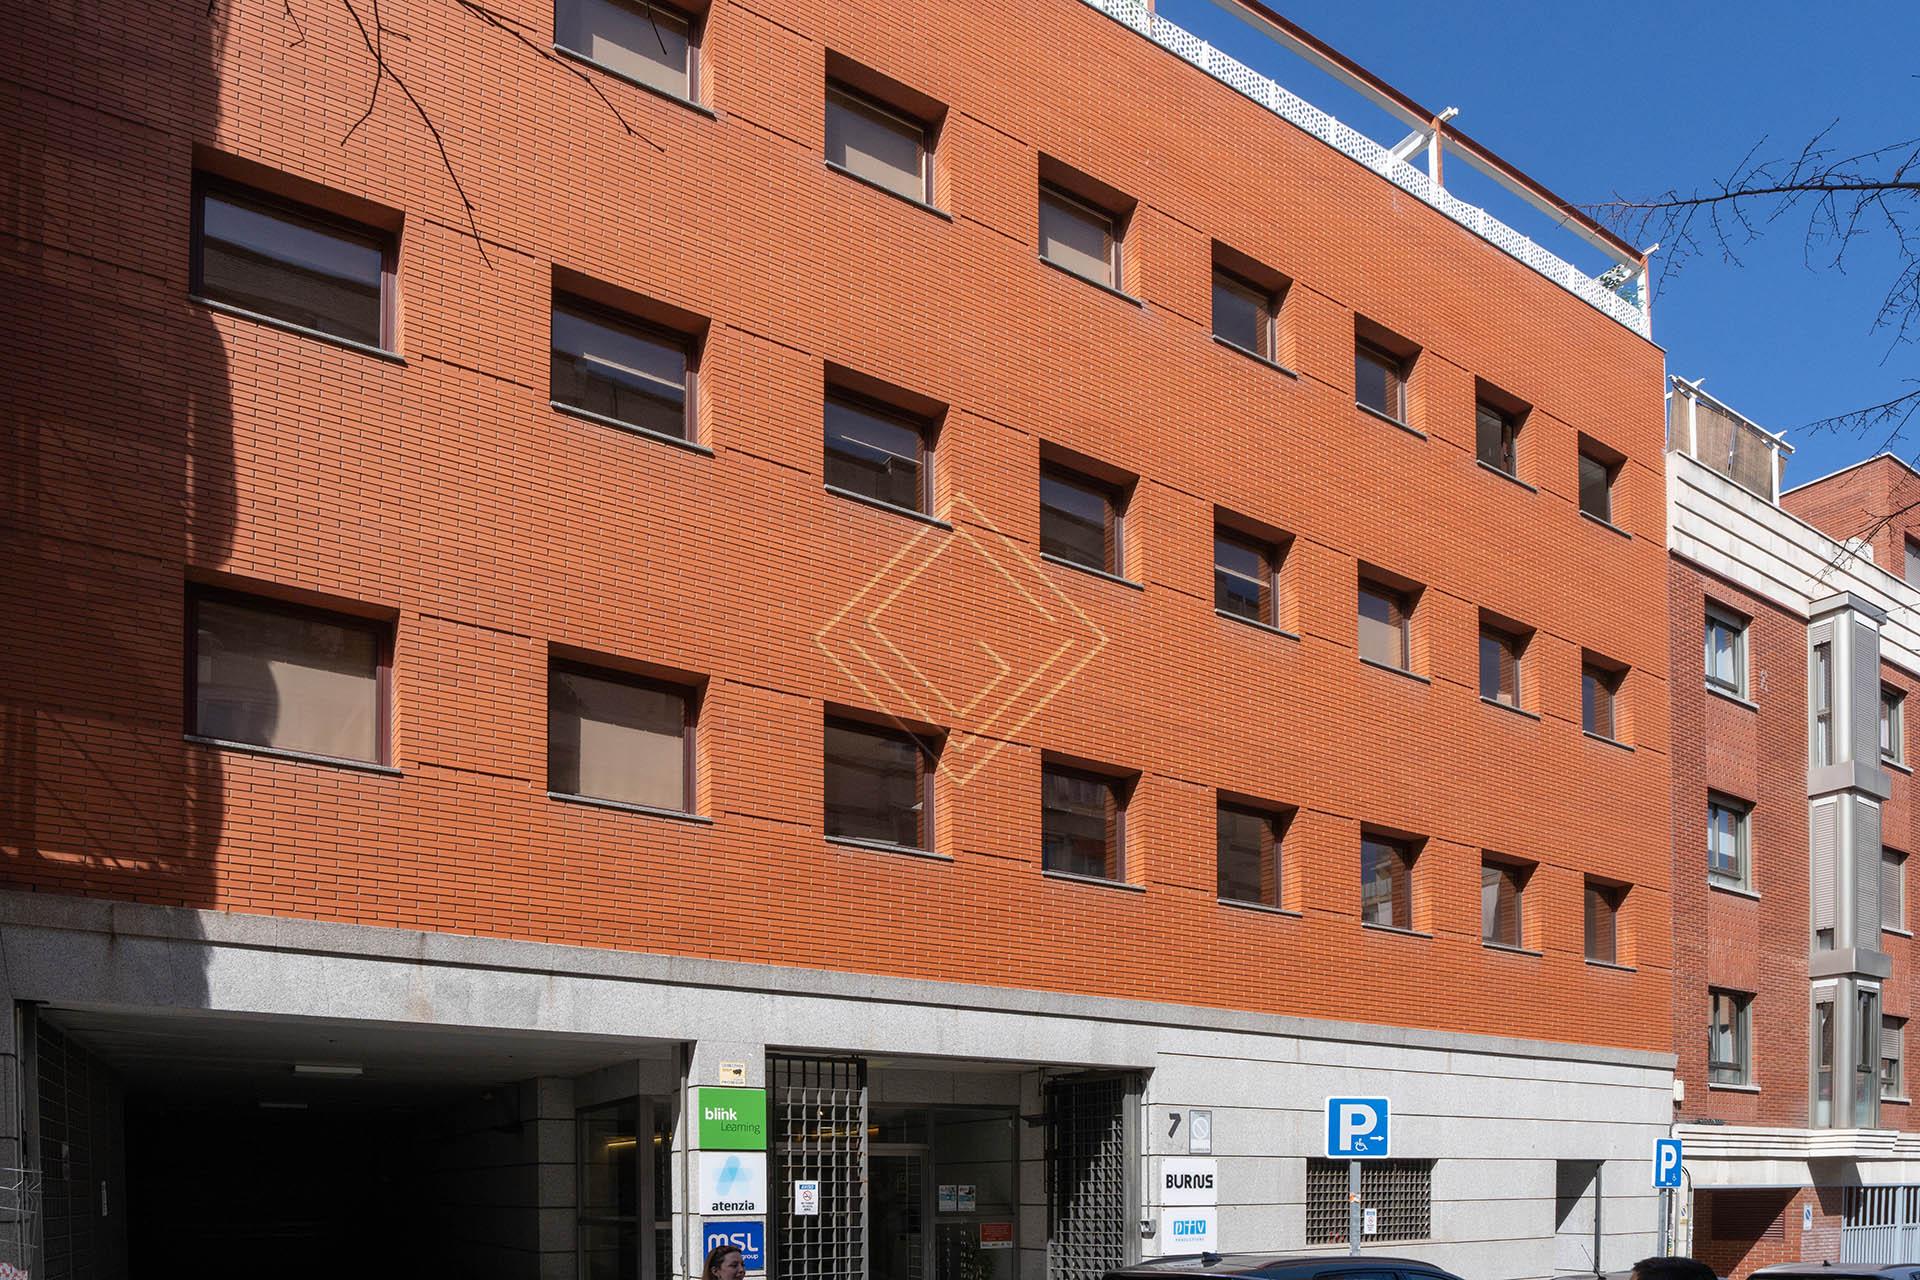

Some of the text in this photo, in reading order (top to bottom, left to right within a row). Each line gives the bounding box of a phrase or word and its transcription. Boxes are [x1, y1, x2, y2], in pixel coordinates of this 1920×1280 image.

[705, 1107, 737, 1120] blink
[721, 1120, 760, 1135] Learning
[1168, 1113, 1181, 1138] 7
[1340, 1104, 1377, 1150] P
[1660, 1145, 1677, 1182] P
[712, 1200, 755, 1211] atenzia
